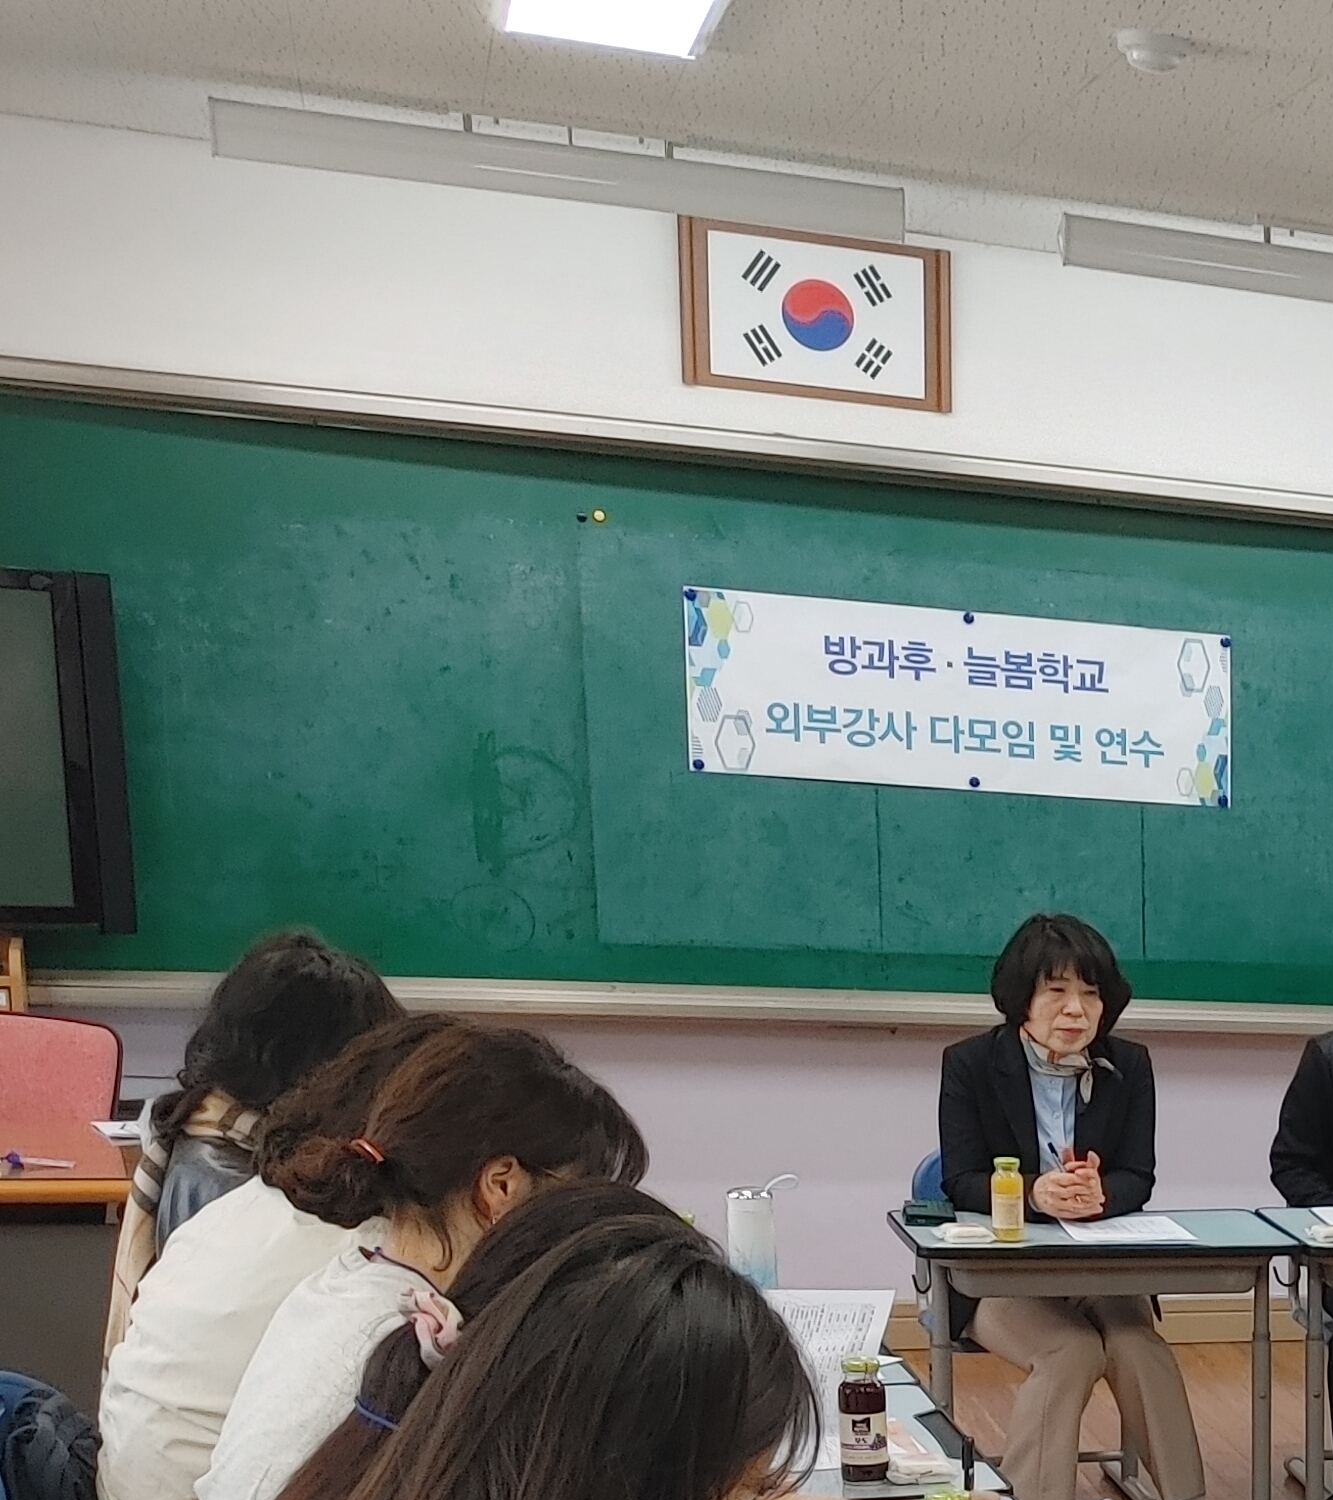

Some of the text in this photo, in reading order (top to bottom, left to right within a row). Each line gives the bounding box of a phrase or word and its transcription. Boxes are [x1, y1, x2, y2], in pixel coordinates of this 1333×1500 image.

[764, 702, 1165, 768] 외부강사 다모임 및 연수
